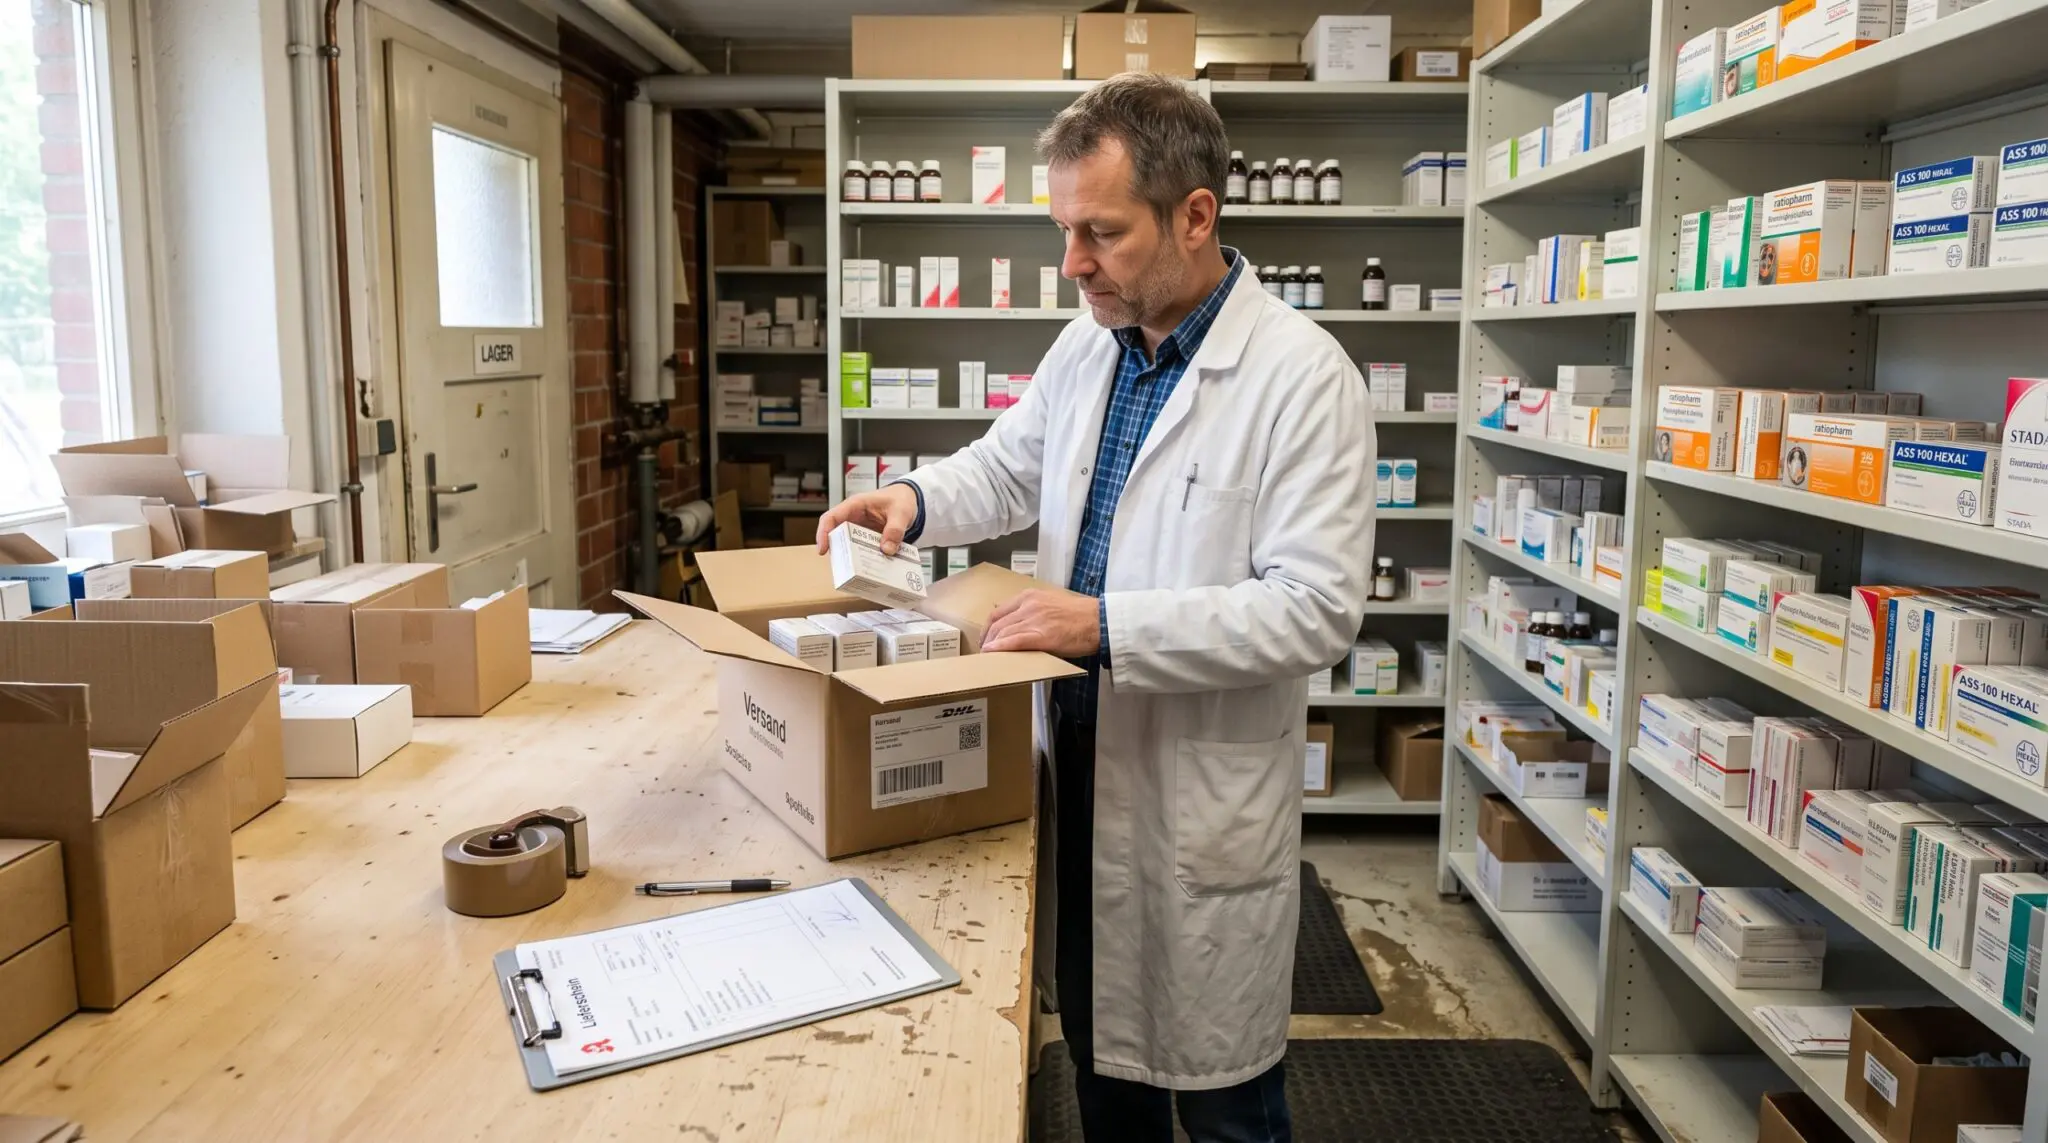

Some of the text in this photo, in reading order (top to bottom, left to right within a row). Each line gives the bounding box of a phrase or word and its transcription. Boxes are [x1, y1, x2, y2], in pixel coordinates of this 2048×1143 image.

[2006, 143, 2047, 161] ASS 100
[1900, 173, 1916, 185] ASS
[1918, 170, 1931, 180] 100
[1773, 193, 1813, 208] ratiopharm
[2000, 208, 2021, 222] ASS
[2022, 206, 2038, 218] 100
[1895, 225, 1912, 237] ASS
[1914, 224, 1927, 234] 100
[481, 344, 514, 363] LAGER
[1669, 393, 1701, 405] ratiopharm
[1814, 423, 1853, 437] ratiopharm
[1896, 447, 1915, 459] ASS
[1917, 449, 1933, 461] 100
[2007, 518, 2032, 530] STADA
[852, 528, 868, 539] ASS
[1959, 675, 2039, 714] ASS 100 HEXAL
[743, 691, 786, 744] Versand
[942, 705, 976, 718] DHL
[566, 977, 597, 1029] Lieferschein
